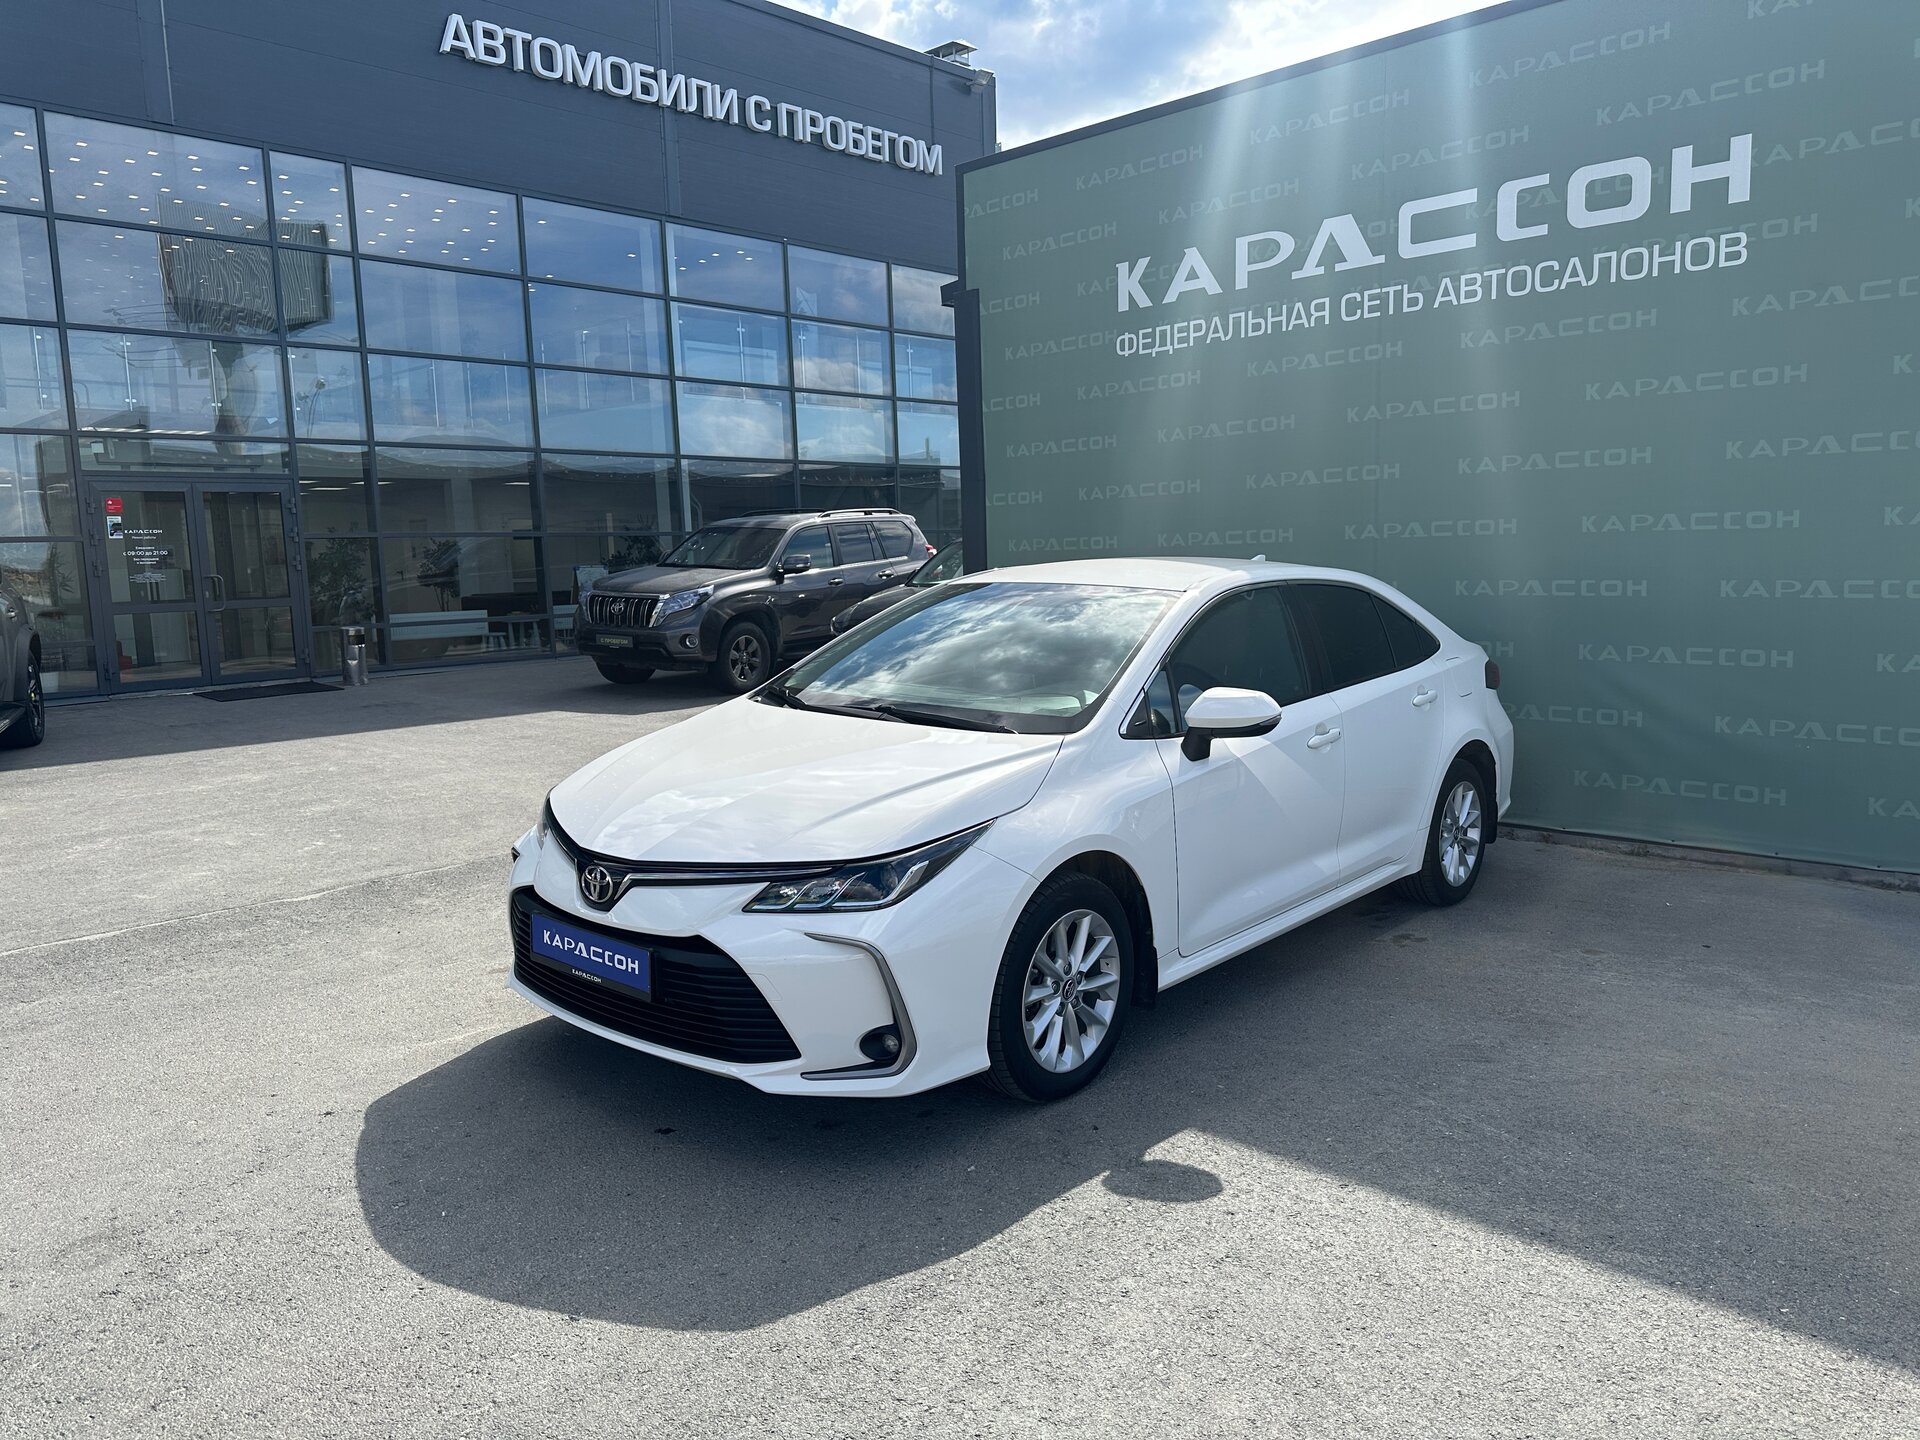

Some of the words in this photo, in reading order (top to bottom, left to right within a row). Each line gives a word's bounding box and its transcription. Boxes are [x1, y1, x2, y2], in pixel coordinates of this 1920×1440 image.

[1469, 22, 1671, 89] КАРАССОН
[440, 13, 738, 125] АВТОМОБИЛИ
[746, 95, 771, 132] С
[777, 102, 943, 176] ПРОБЕГОМ
[1597, 59, 1826, 126] КАРАССОН
[1249, 89, 1410, 145] КАРАССОН
[1076, 145, 1203, 191] КАРАССОН
[1351, 124, 1531, 181] КАРАССОН
[1158, 178, 1300, 225] КАРАССОН
[1003, 221, 1117, 261] КАРАССОН
[1116, 133, 1753, 313] КАРАССОН
[1115, 297, 1331, 357] ФЕДЕРАЛЬНАЯ
[1340, 284, 1424, 323] СЕТЬ
[1433, 231, 1749, 308] АВТОСАЛОНОВ
[1460, 308, 1658, 348] КАРАССОН
[1247, 341, 1403, 377] КАРАССОН
[1077, 369, 1201, 400] КАРАССОН
[1585, 363, 1808, 401] КАРАССОН
[1347, 391, 1520, 423] КАРАССОН
[1006, 434, 1117, 458] КАРАССОН
[1157, 414, 1295, 444] КАРАССОН
[1726, 430, 1920, 459] КАРАСС
[1246, 463, 1400, 490] КАРАССОН
[1458, 446, 1653, 474] КАРАССОН
[1078, 479, 1201, 501] КАРАССОН
[1157, 527, 1294, 548] КАРАССОН
[1345, 518, 1517, 540] КАРАССОН
[1582, 509, 1801, 534] КАРАССОН
[1009, 536, 1118, 552] КАРАССОН
[1455, 579, 1648, 597] КАРАССОН
[1578, 643, 1794, 668] КАРАССОН
[1574, 770, 1787, 806] КАРАССОН
[543, 929, 639, 975] КАРАССОН
